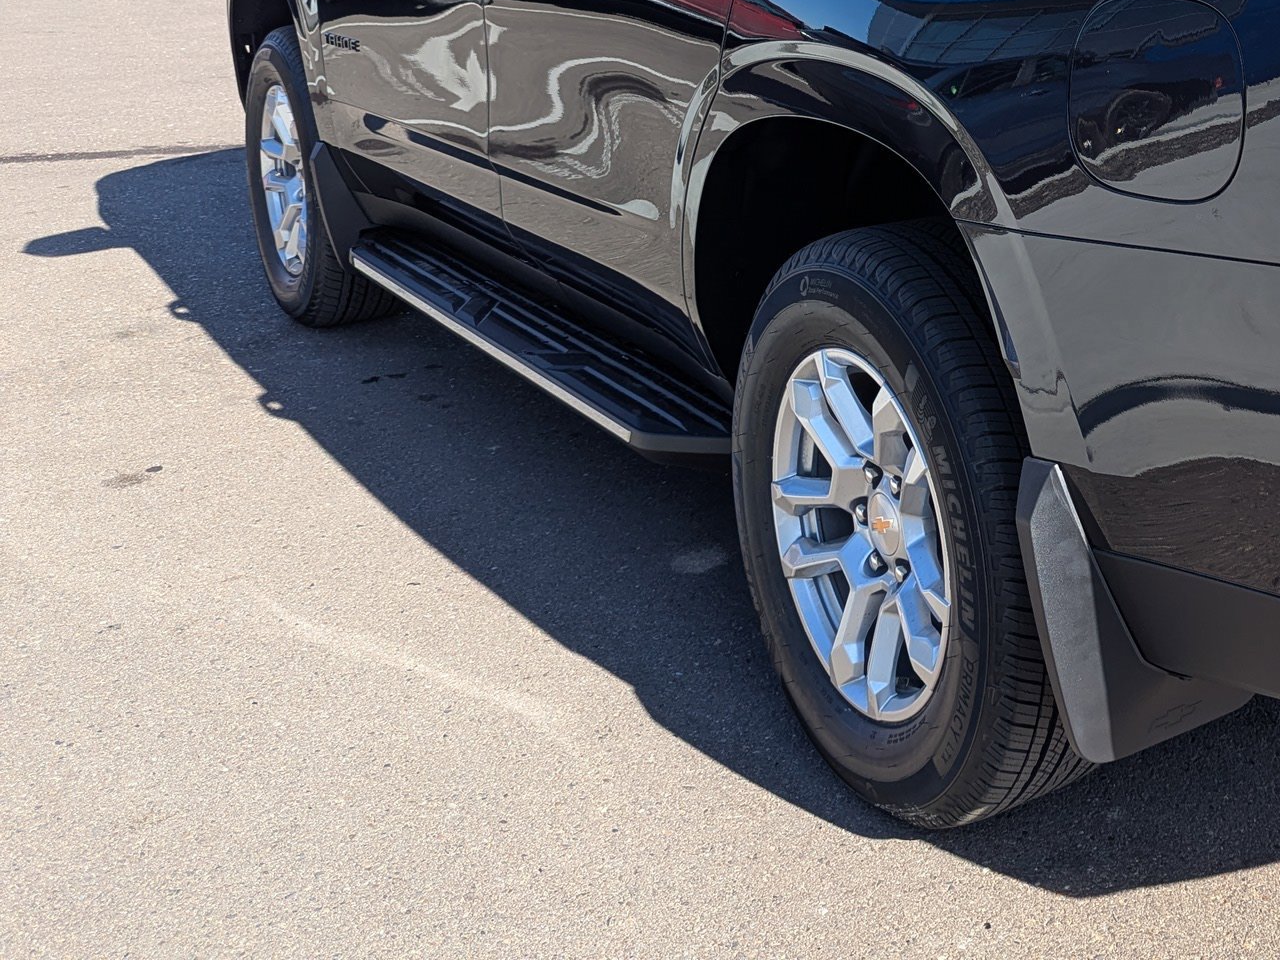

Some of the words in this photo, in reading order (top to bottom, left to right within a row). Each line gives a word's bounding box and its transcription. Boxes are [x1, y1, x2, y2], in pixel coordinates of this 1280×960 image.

[325, 33, 360, 52] TAHOE
[932, 445, 976, 632] MICHELIN
[950, 657, 978, 743] PRIMACY
